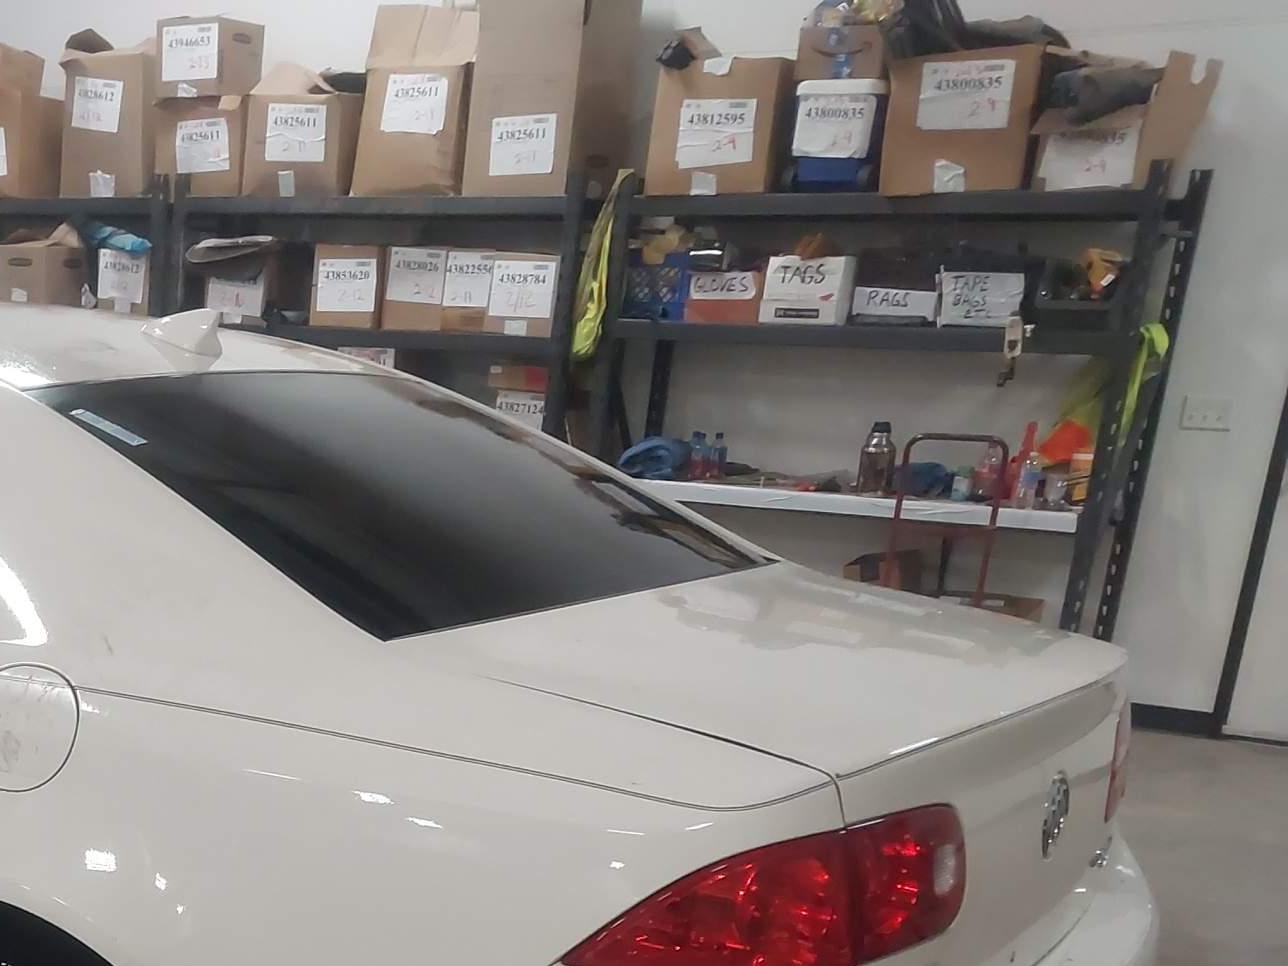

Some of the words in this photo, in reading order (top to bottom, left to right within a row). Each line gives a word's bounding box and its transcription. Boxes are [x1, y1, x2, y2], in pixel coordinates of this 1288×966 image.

[933, 75, 1004, 92] 43800835
[394, 85, 439, 98] 43825611
[687, 112, 746, 126] 43812595
[804, 106, 865, 120] 43800835
[273, 116, 317, 128] 43825611
[496, 127, 546, 140] 43825611
[498, 272, 547, 285] 43828784
[780, 263, 826, 285] TAGS
[693, 276, 749, 293] GLOVES
[951, 275, 991, 292] TAPE
[866, 289, 909, 308] RAGS
[951, 294, 987, 307] BAGS
